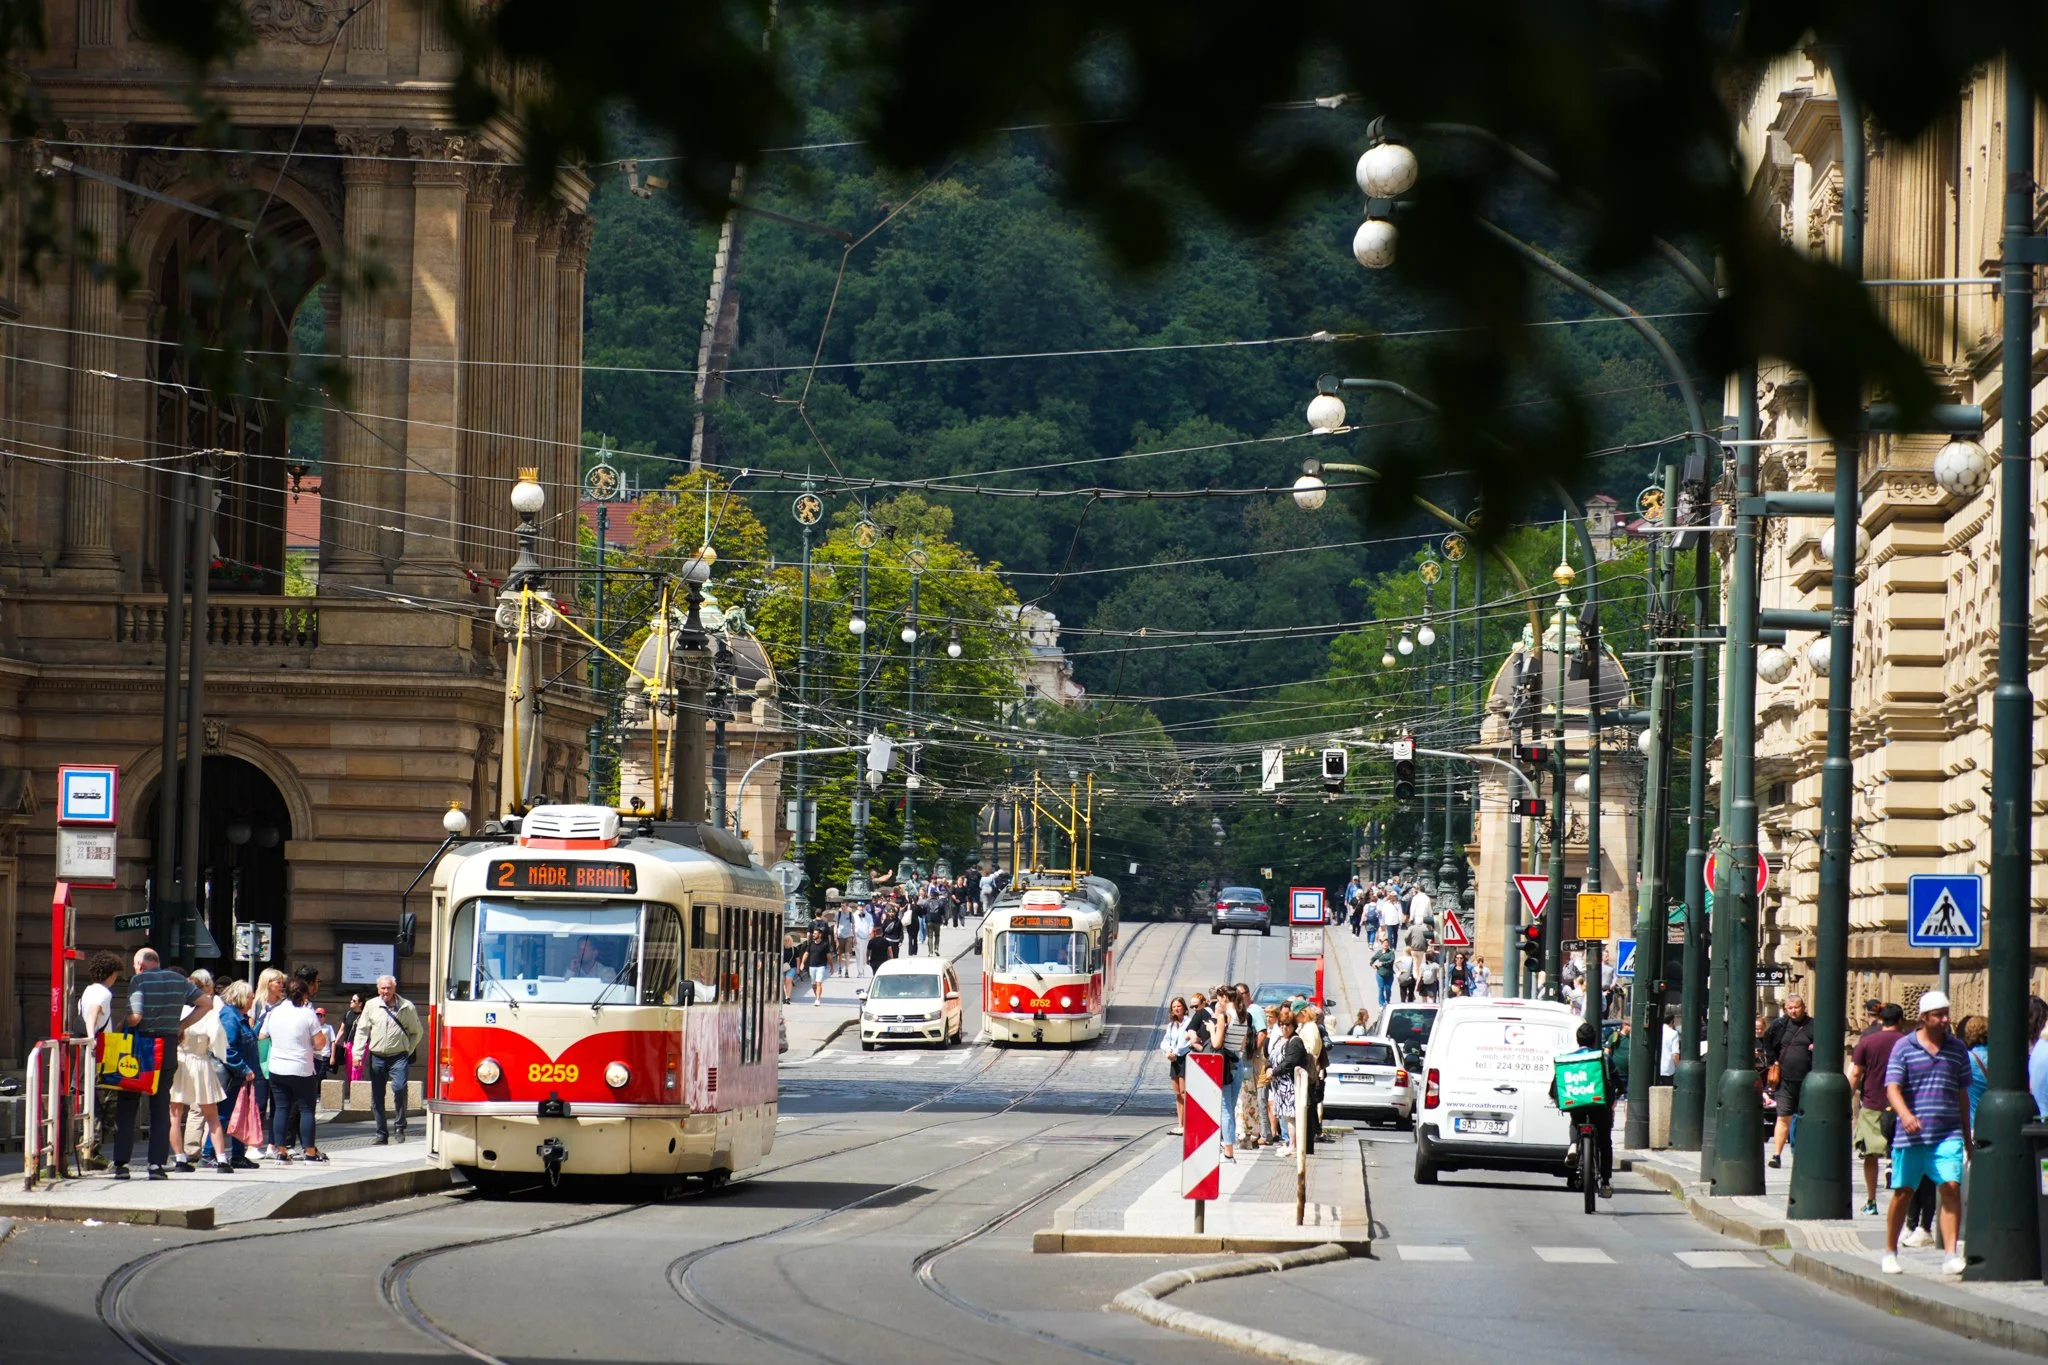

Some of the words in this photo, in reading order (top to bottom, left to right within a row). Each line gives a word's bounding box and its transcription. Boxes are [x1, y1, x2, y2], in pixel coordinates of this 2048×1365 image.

[1514, 745, 1522, 758] L
[1512, 800, 1520, 813] P
[499, 862, 516, 887] 2
[528, 863, 570, 886] NÁDR.
[576, 865, 631, 888] BRANÍK
[127, 917, 140, 928] WC
[1011, 916, 1025, 926] 22
[1030, 999, 1051, 1007] 8752
[528, 1063, 579, 1083] 8259
[1496, 1062, 1512, 1070] 224
[1515, 1063, 1531, 1071] 920
[1533, 1064, 1550, 1072] 887
[1564, 1070, 1588, 1085] Bolt
[1566, 1082, 1595, 1097] Food
[1461, 1120, 1477, 1129] 9AJ
[1483, 1121, 1504, 1131] 7932
